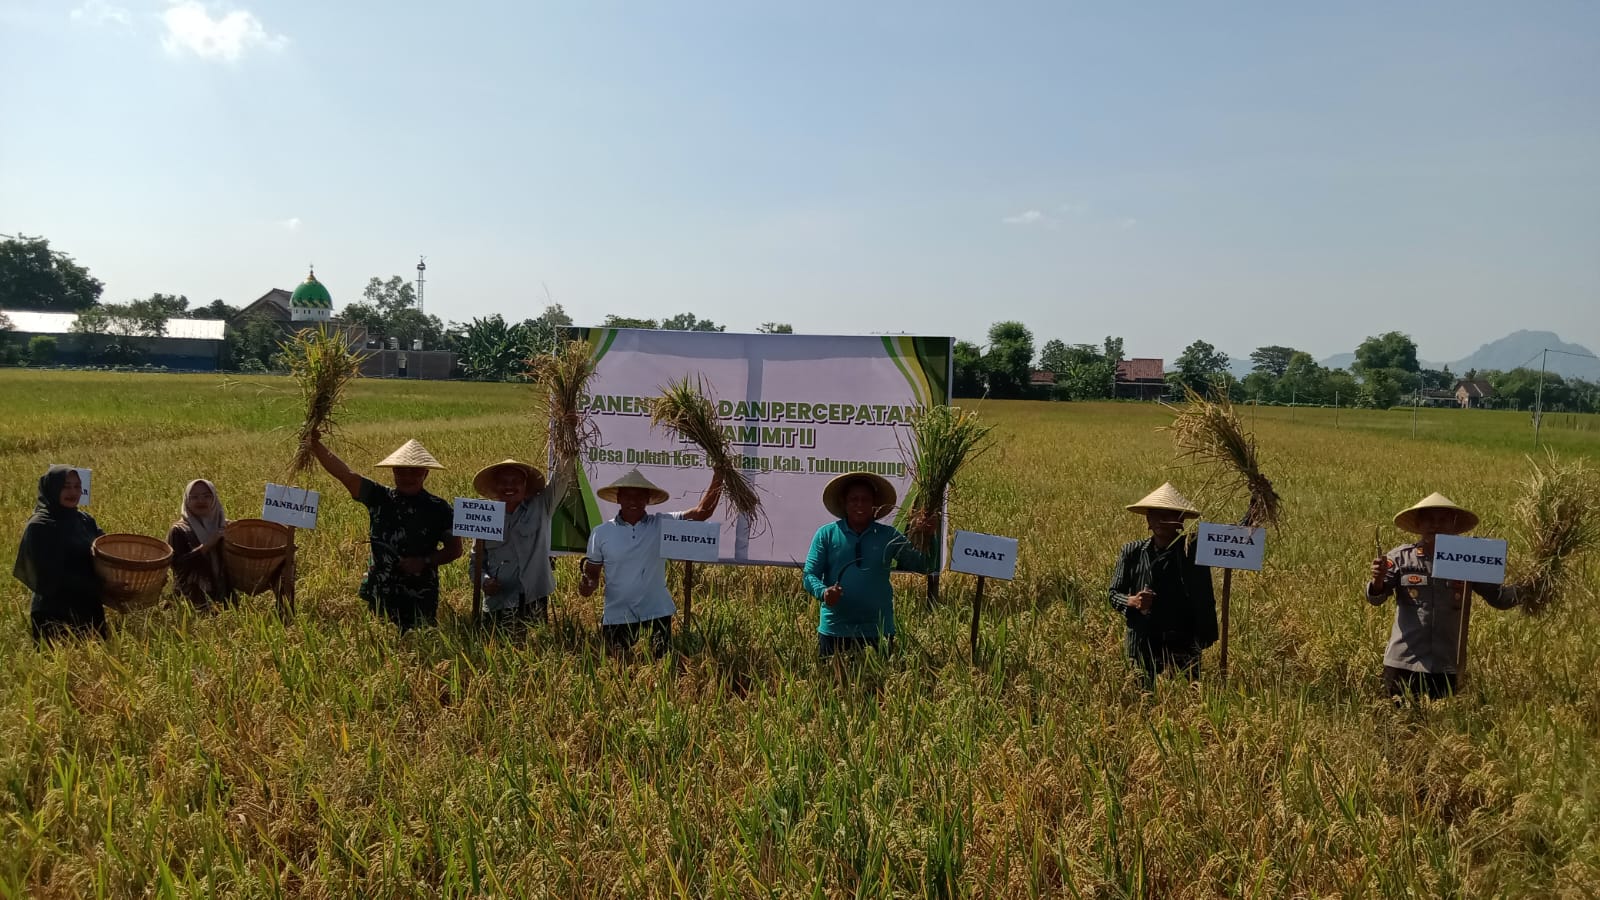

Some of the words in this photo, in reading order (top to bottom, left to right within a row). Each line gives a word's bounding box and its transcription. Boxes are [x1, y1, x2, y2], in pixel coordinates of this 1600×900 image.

[718, 400, 768, 421] DAN
[762, 427, 797, 447] MT
[588, 447, 624, 465] Desa
[626, 449, 670, 466] Dukuh
[673, 451, 703, 468] Kec.
[773, 455, 804, 472] Kab.
[265, 497, 316, 514] DANRAMIL
[462, 501, 496, 512] KEPALA
[465, 513, 492, 522] DINAS
[454, 523, 503, 535] PERTANIAN
[681, 535, 716, 545] BUPATI
[1207, 533, 1255, 546] KEPALA
[964, 547, 1006, 561] CAMAT
[1214, 547, 1246, 559] DESA
[1436, 551, 1503, 566] KAPOLSEK
